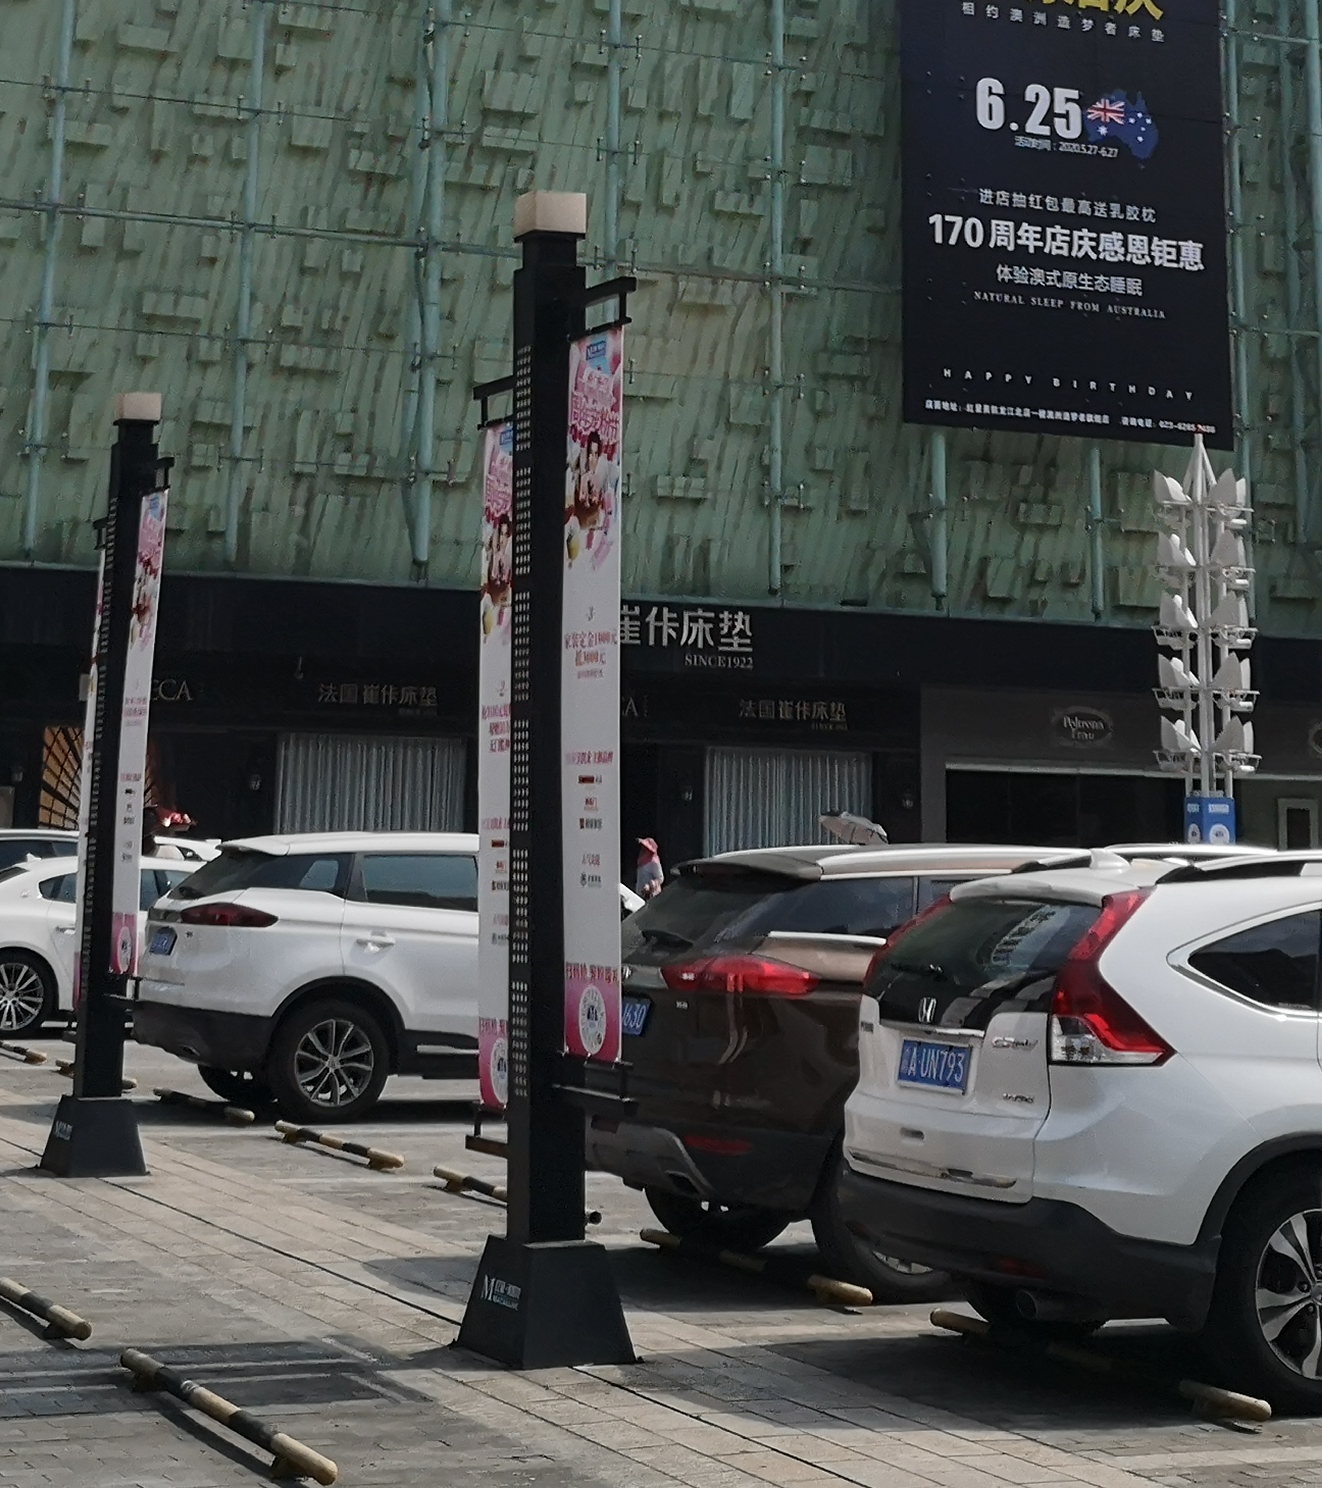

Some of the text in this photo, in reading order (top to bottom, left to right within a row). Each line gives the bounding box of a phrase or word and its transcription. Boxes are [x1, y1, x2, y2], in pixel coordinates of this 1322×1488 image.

[976, 77, 1083, 140] 6.25
[979, 187, 1157, 224] 进店抽红包最高送乳胶枕
[996, 264, 1144, 298] 体验澳式原生态睡眠
[974, 291, 1167, 320] NATURAL SLEEP FROM AUSTRALIA
[943, 367, 1195, 402] HAPPY BIRTHDAY
